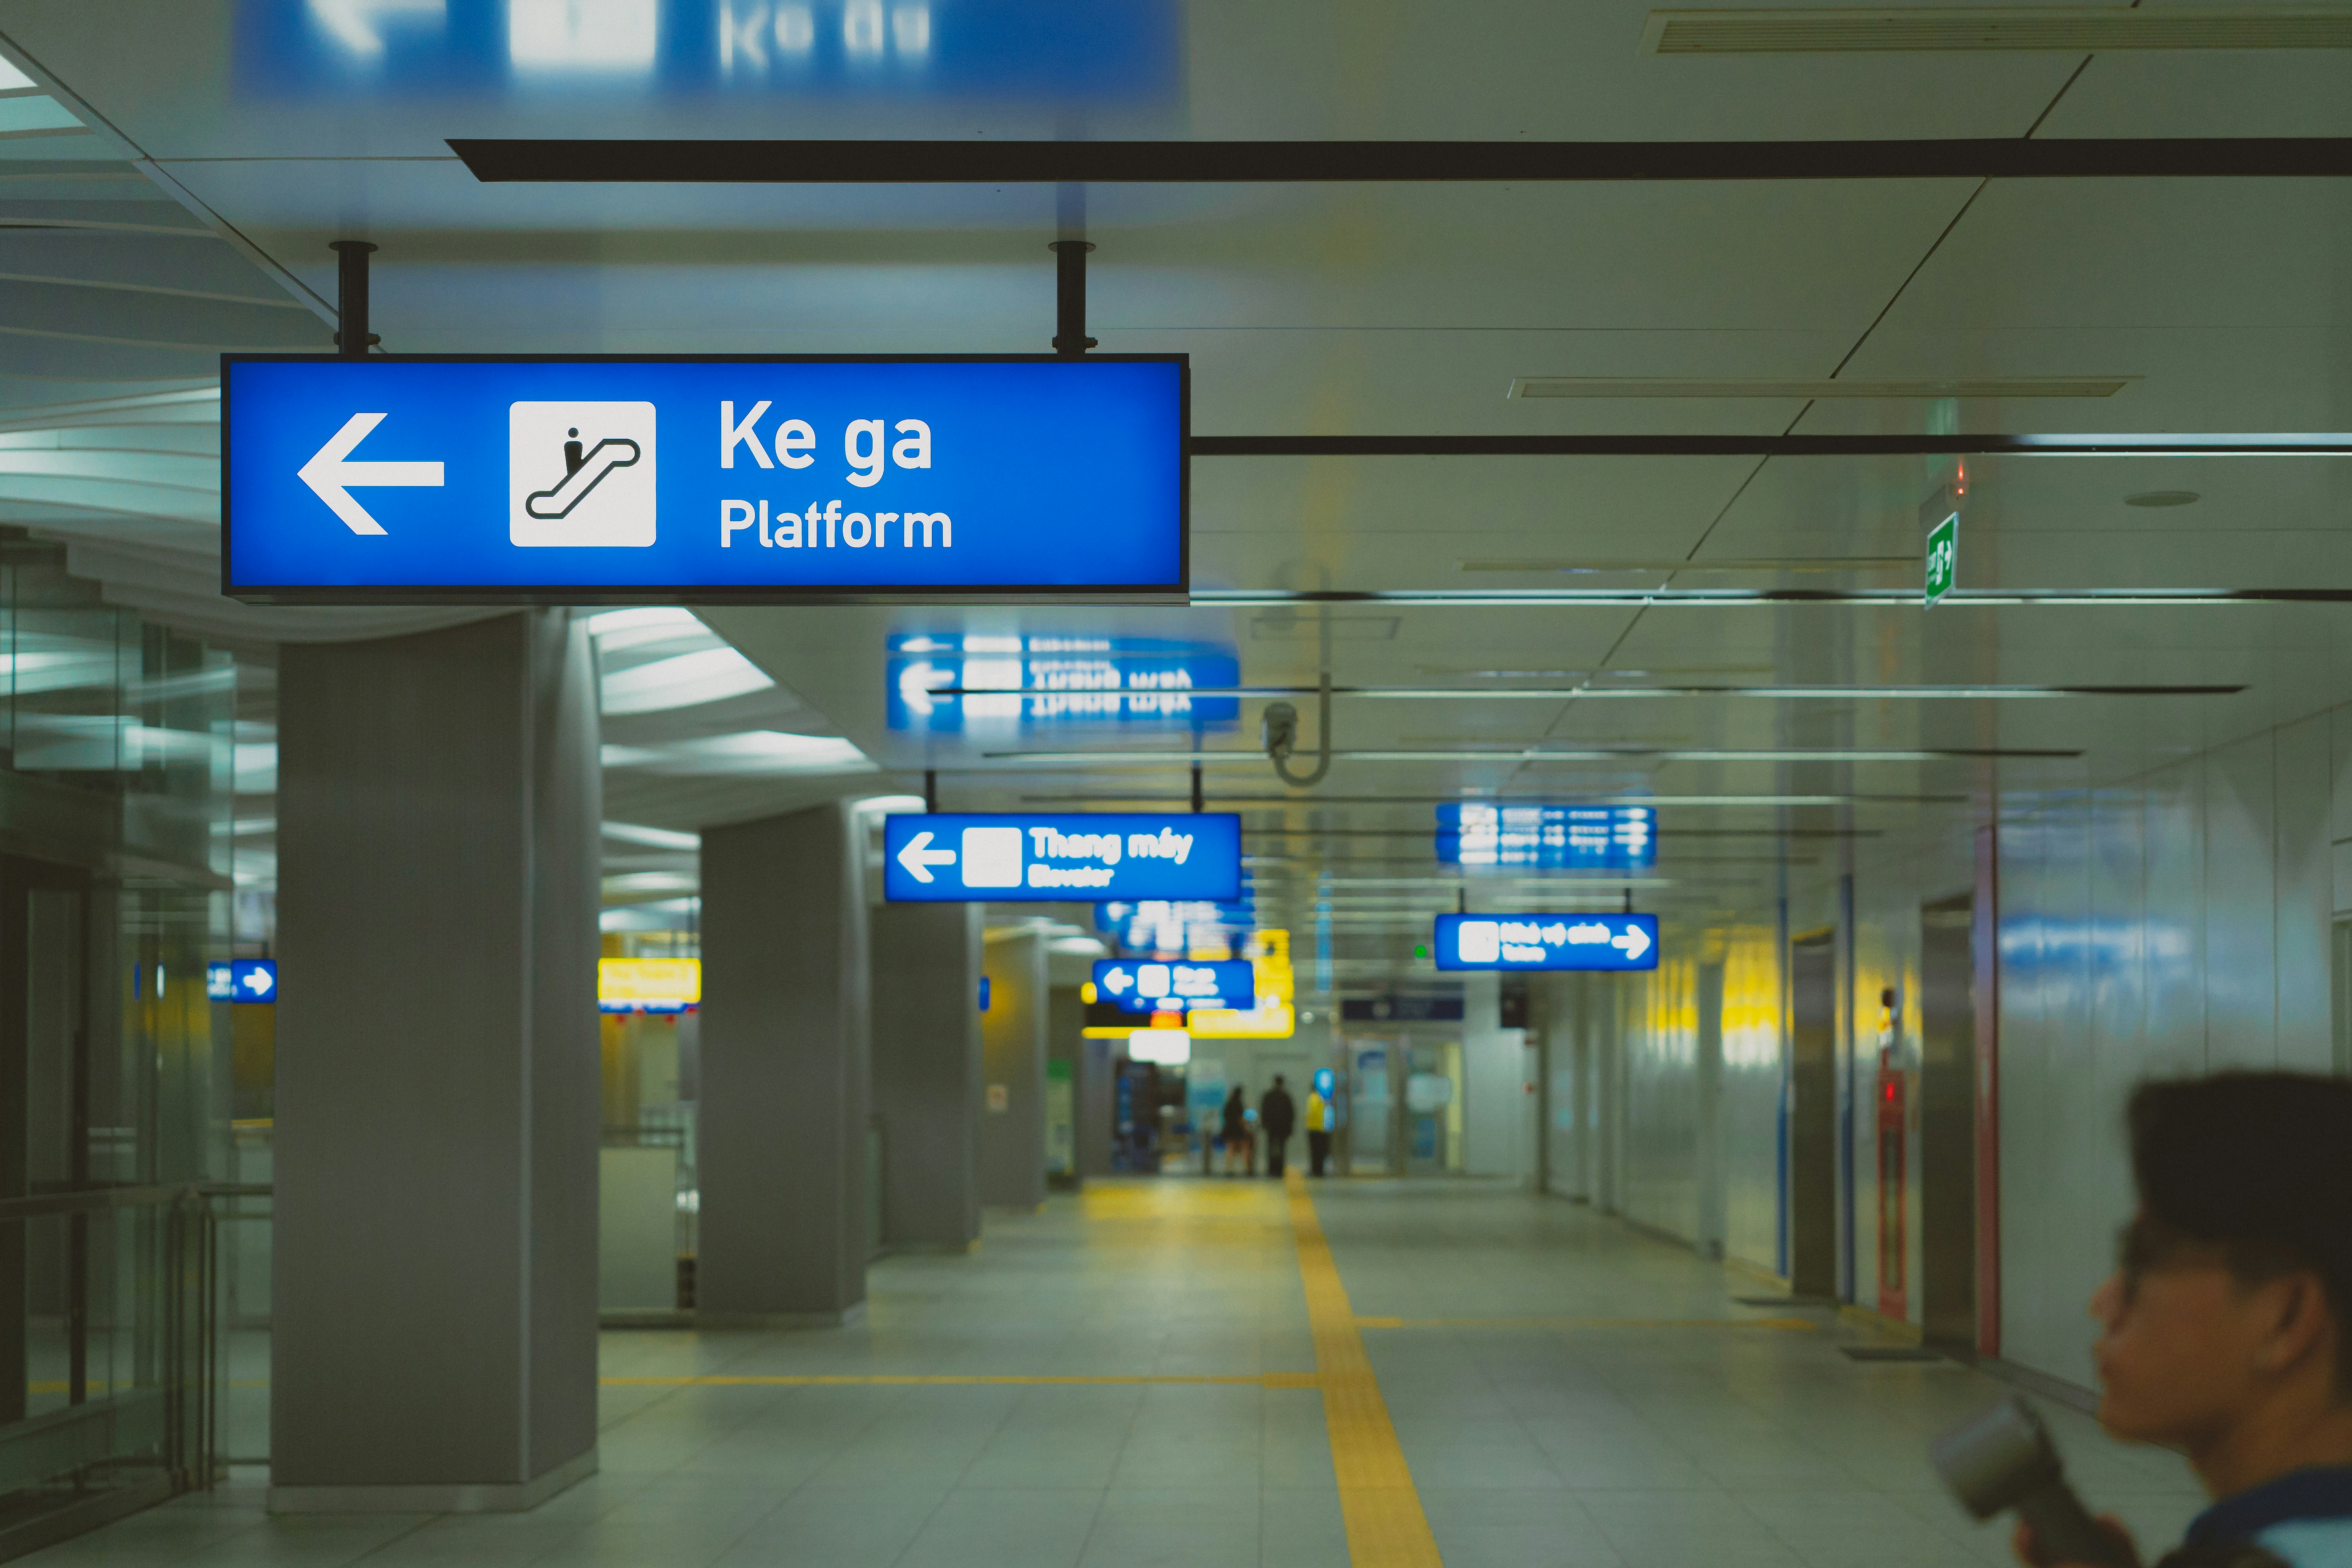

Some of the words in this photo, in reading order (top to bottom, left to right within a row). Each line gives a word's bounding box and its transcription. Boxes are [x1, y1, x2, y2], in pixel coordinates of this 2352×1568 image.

[721, 401, 816, 469] Ke
[845, 419, 931, 488] ga
[721, 499, 952, 548] Platform
[1029, 827, 1122, 865] Thang
[1128, 827, 1193, 865] máy
